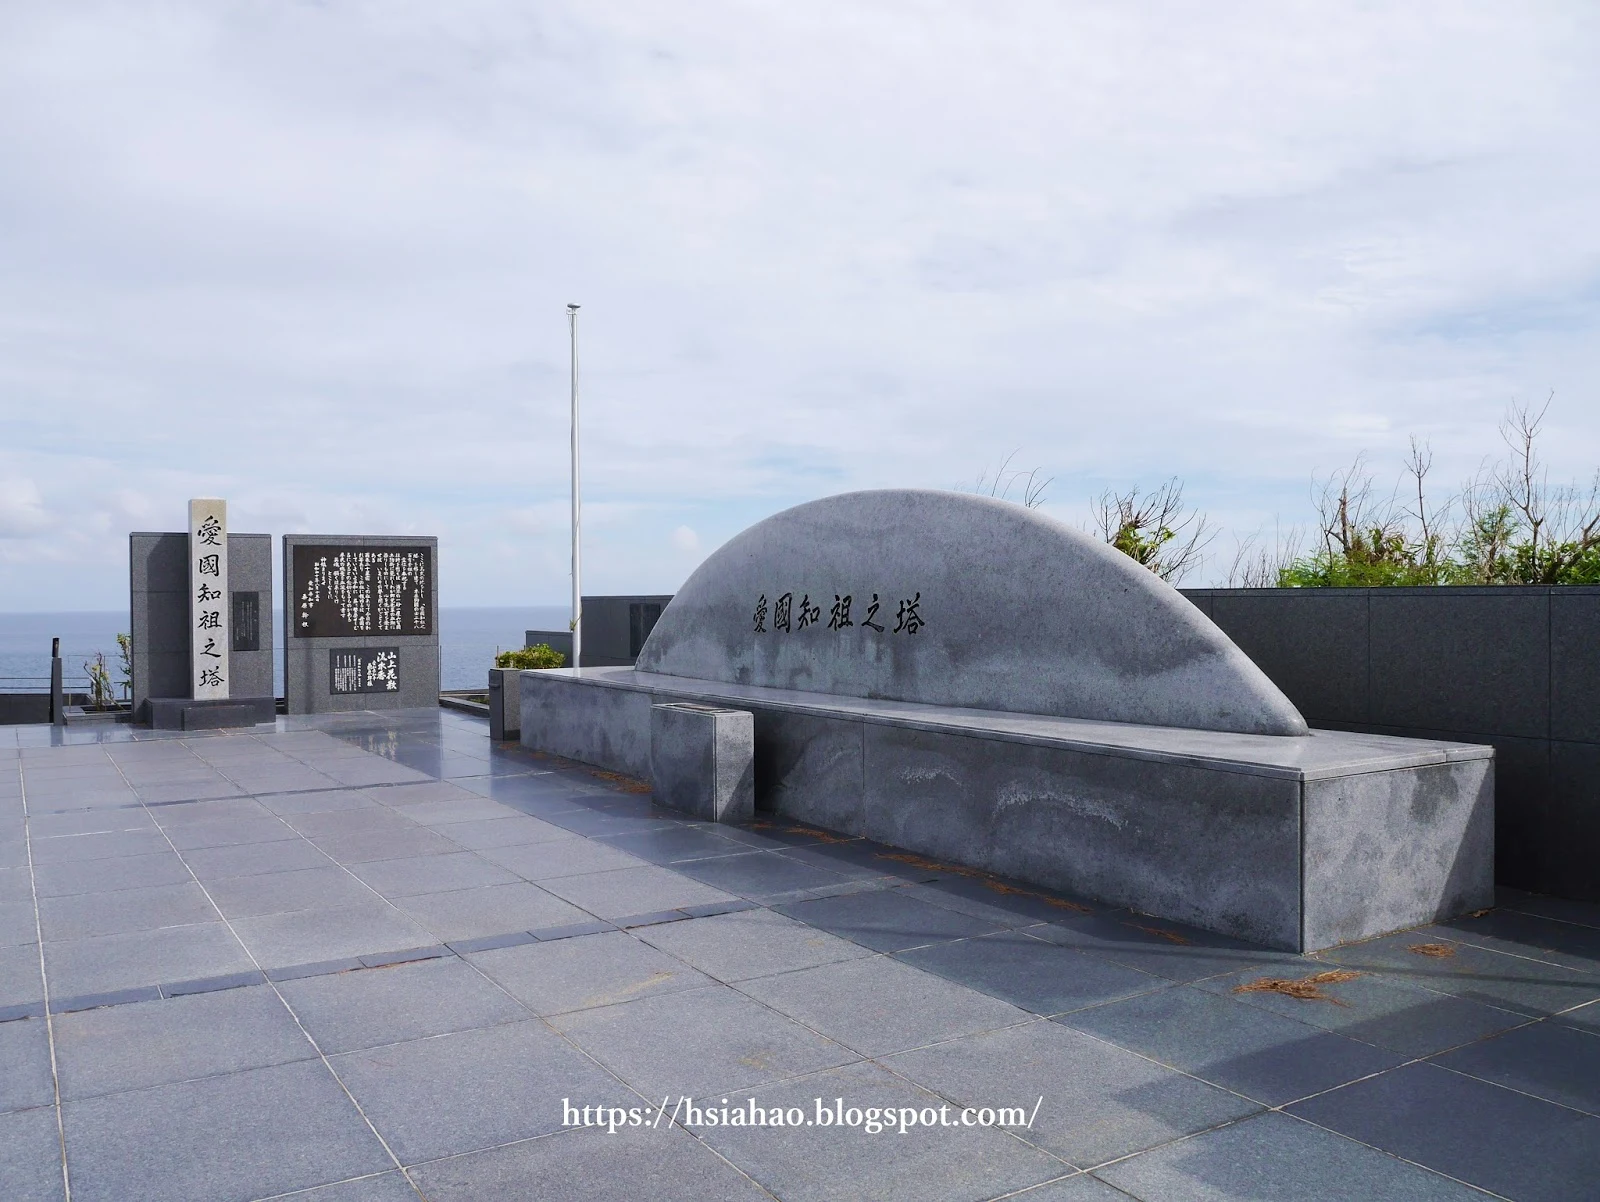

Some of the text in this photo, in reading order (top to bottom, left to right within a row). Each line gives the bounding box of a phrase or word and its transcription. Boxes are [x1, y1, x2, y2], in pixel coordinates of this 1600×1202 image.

[197, 515, 225, 687] 愛國知祖之塔
[753, 592, 925, 635] 愛國知祖之塔
